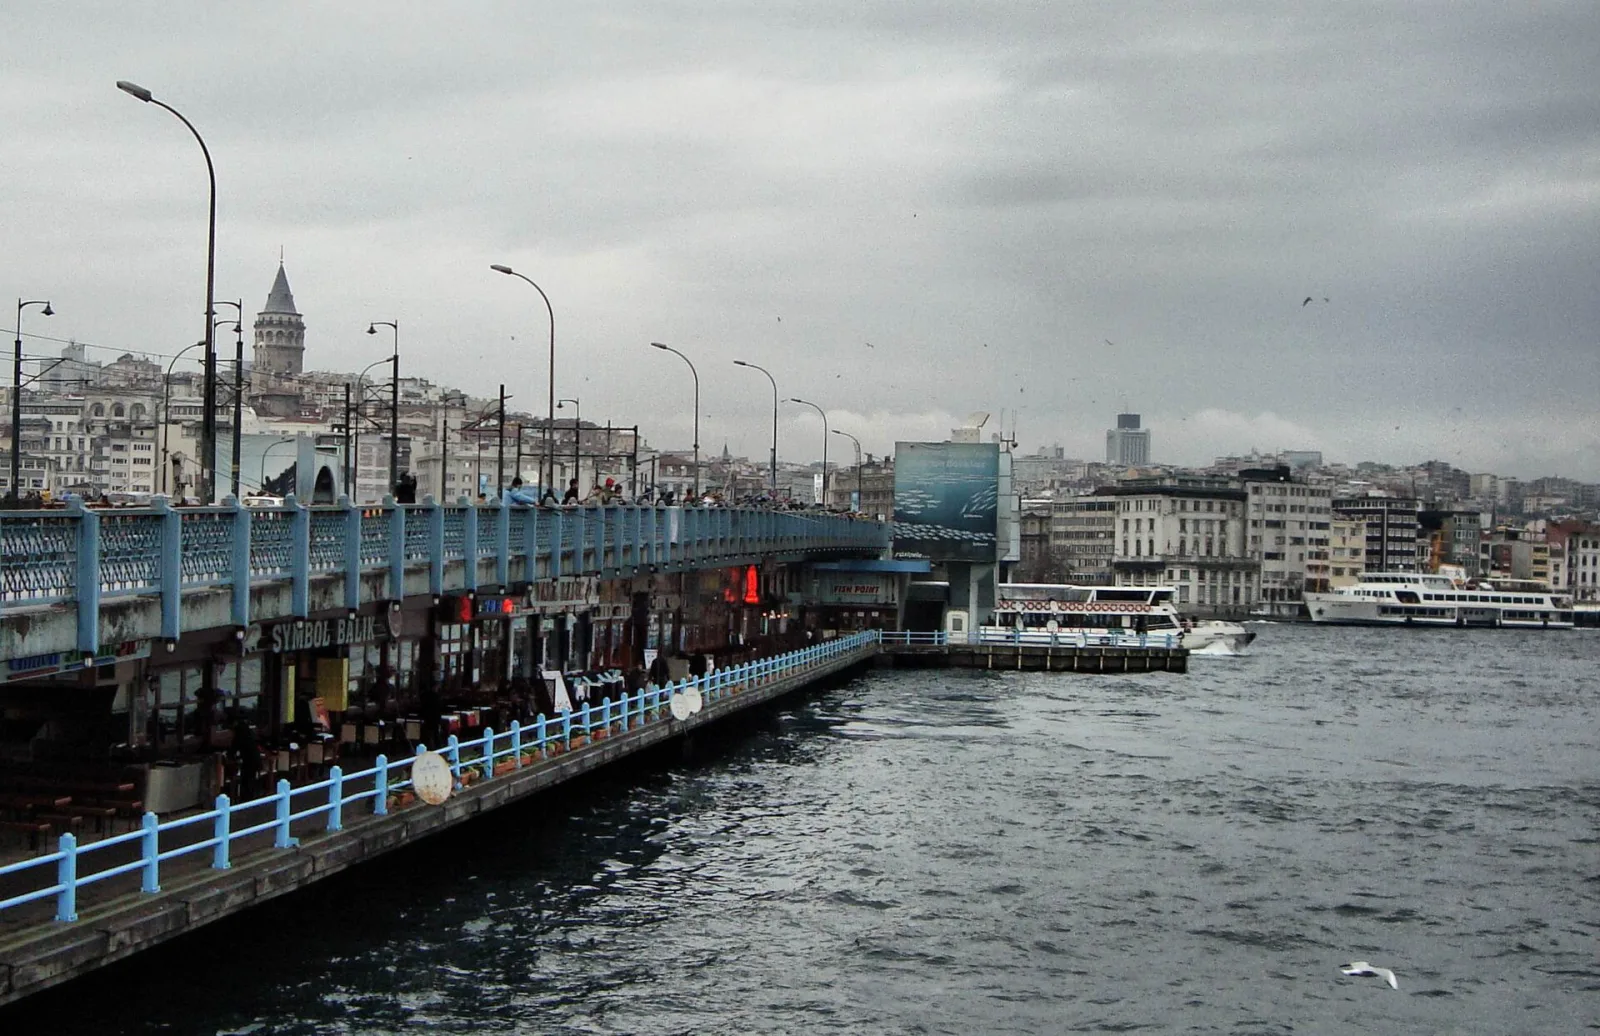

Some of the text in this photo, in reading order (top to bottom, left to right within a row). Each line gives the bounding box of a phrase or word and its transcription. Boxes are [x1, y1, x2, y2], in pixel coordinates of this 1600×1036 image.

[855, 585, 880, 593] POINT
[272, 615, 376, 654] SYMBOL BALIK
